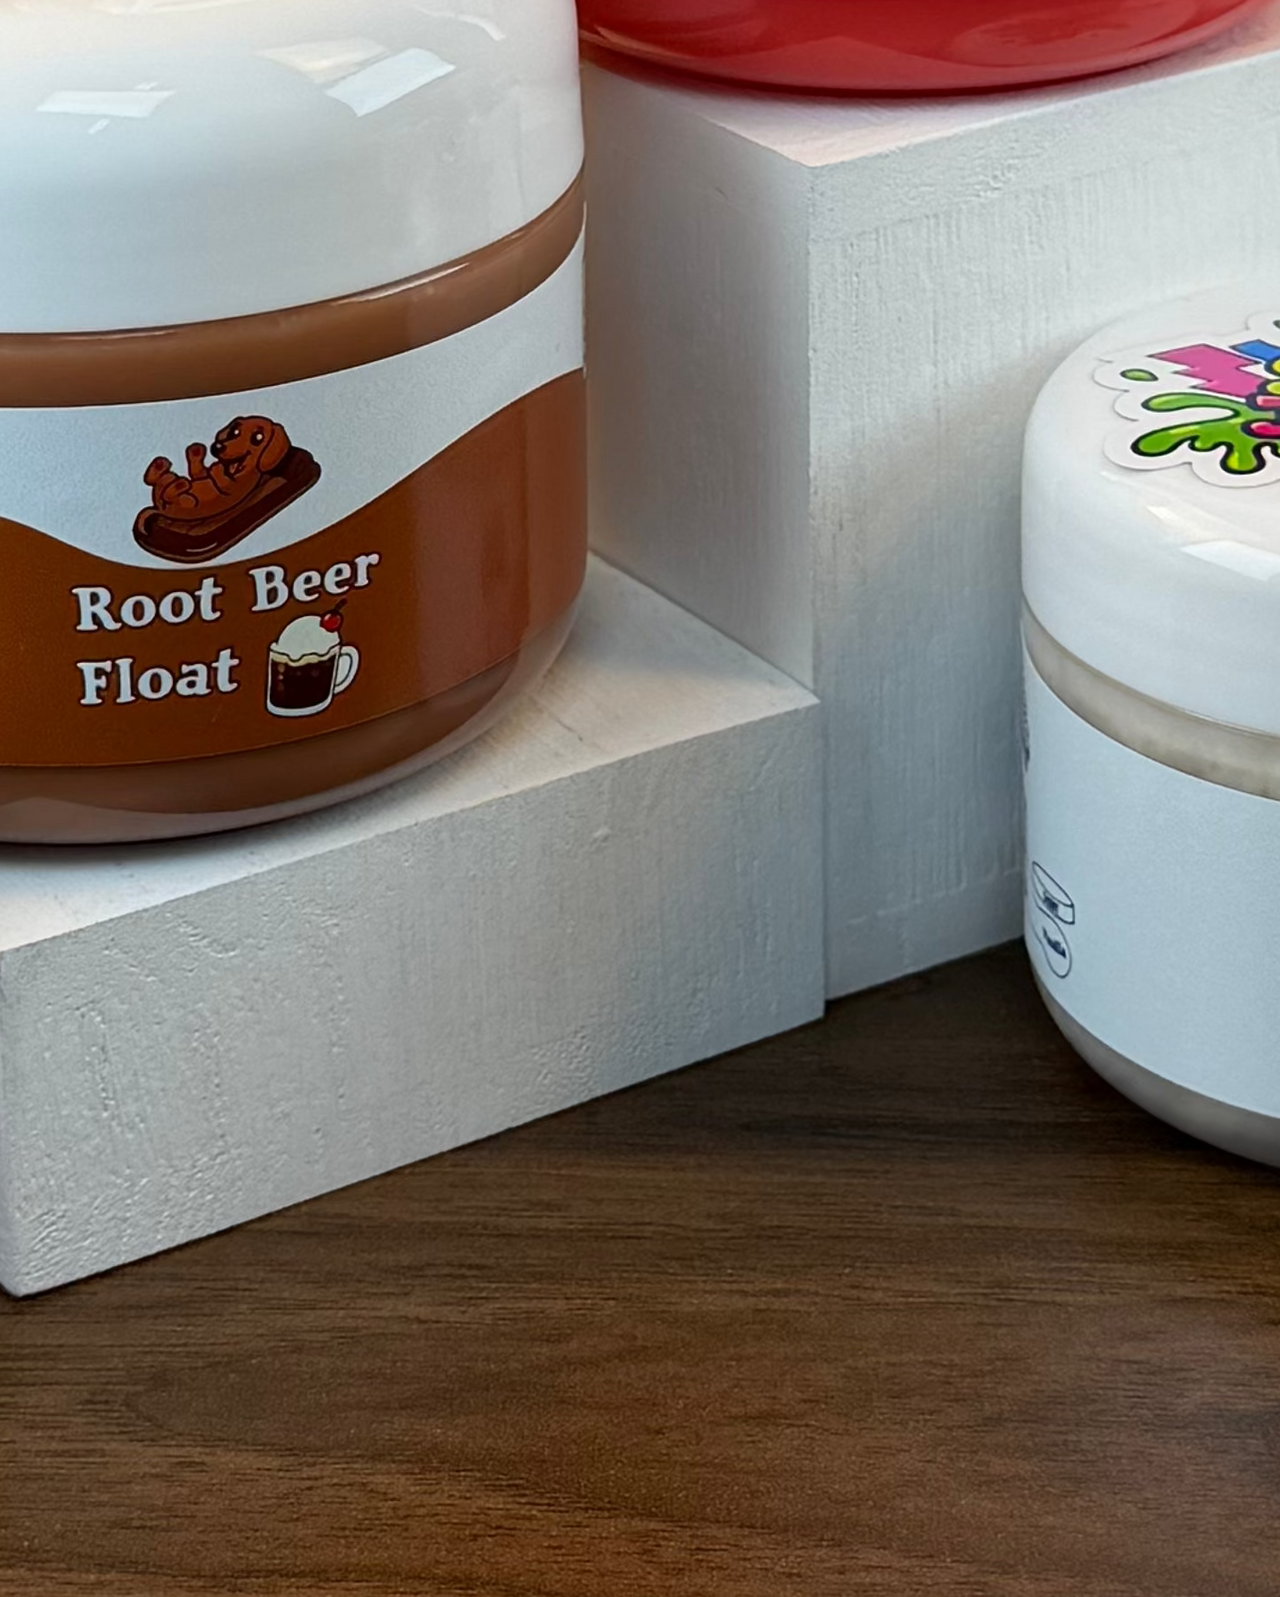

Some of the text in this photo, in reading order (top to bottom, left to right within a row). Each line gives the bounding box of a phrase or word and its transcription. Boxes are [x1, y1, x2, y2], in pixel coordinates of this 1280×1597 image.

[71, 552, 381, 632] Root Beer
[75, 647, 241, 706] Float
